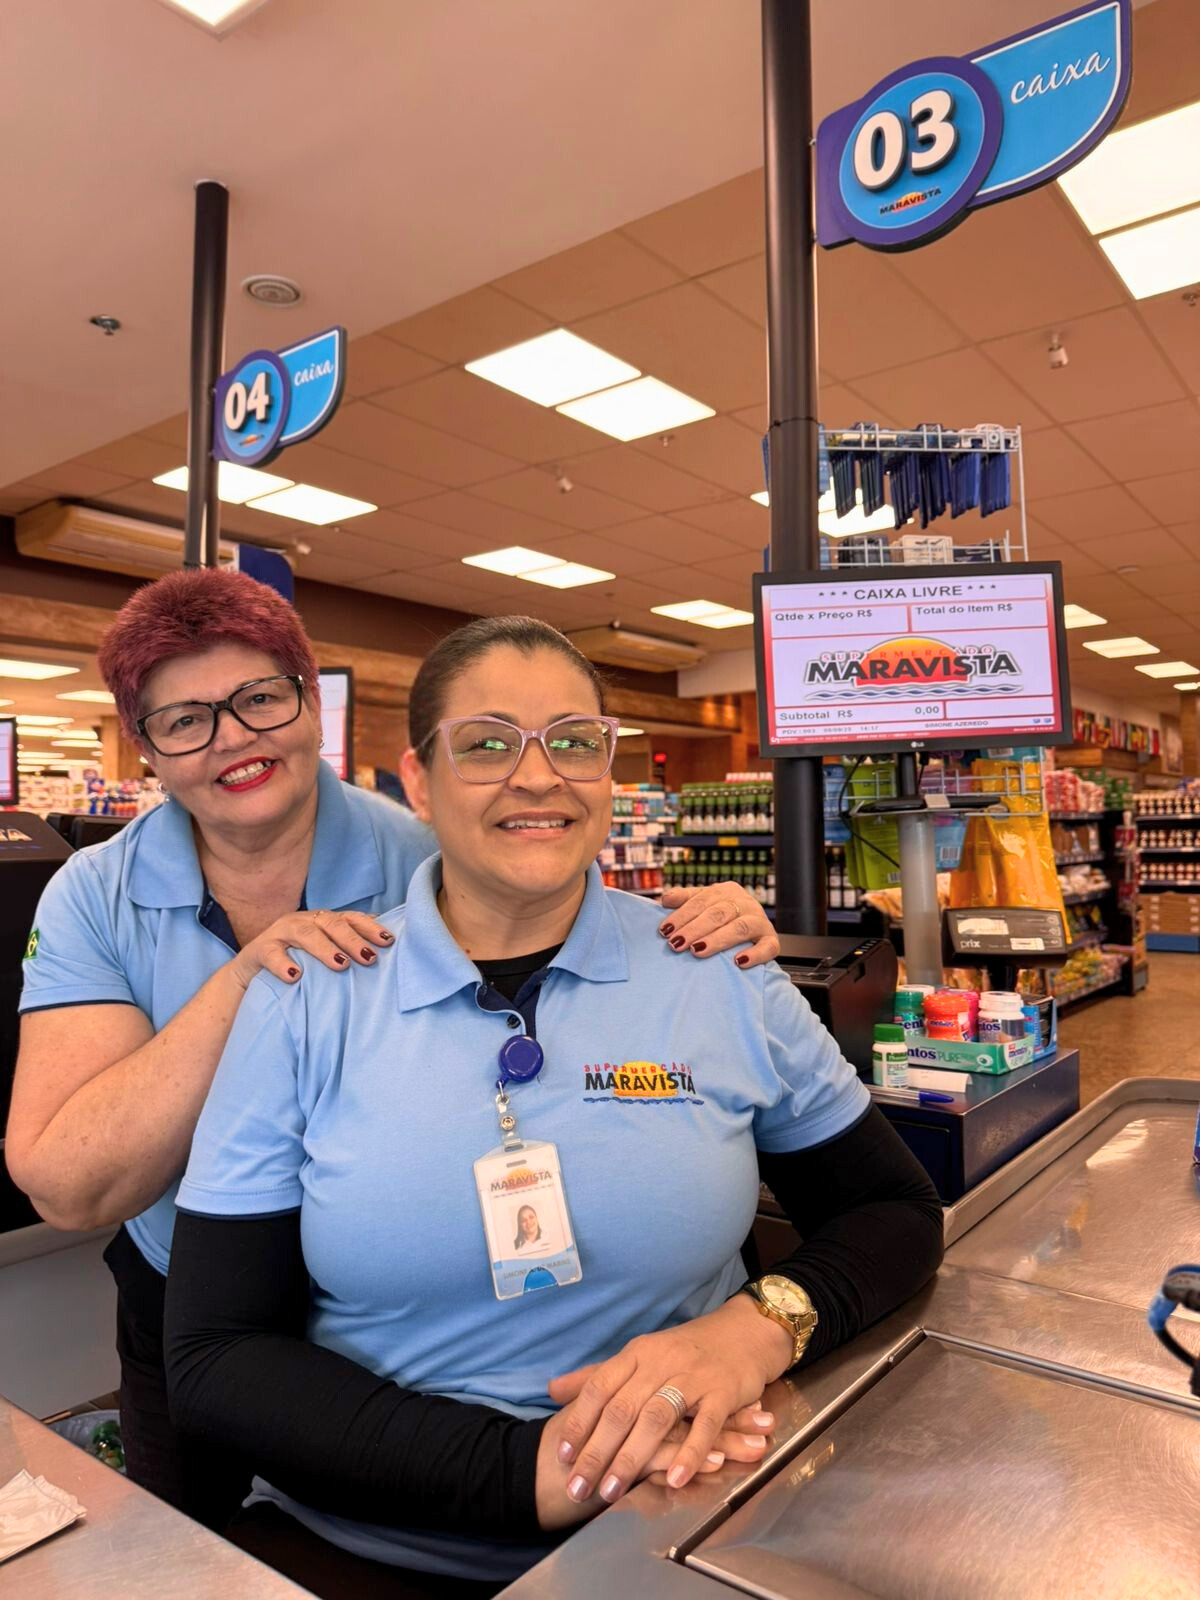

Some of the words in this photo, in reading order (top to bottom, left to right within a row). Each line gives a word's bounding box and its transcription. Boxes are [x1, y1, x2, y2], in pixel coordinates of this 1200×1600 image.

[1010, 51, 1111, 105] caixa
[853, 89, 957, 190] 03
[879, 187, 942, 215] MARAVISTA
[294, 359, 334, 387] caixa
[224, 372, 270, 431] 04
[853, 587, 907, 601] CAIXA
[912, 585, 963, 598] LIVRE
[774, 612, 804, 622] Qtde
[818, 610, 853, 620] Preço
[857, 609, 872, 618] R$
[916, 606, 945, 615] Total
[948, 604, 964, 613] do
[967, 604, 993, 612] Item
[997, 603, 1013, 611] R$
[807, 653, 1018, 683] MARAVISTA
[779, 710, 830, 721] Subtotal
[837, 708, 853, 718] R$
[914, 705, 940, 716] 0,00
[960, 938, 981, 949] prix
[907, 1047, 937, 1060] ntos
[585, 1071, 696, 1095] MARAVISTA
[490, 1169, 552, 1192] MARAVISTA
